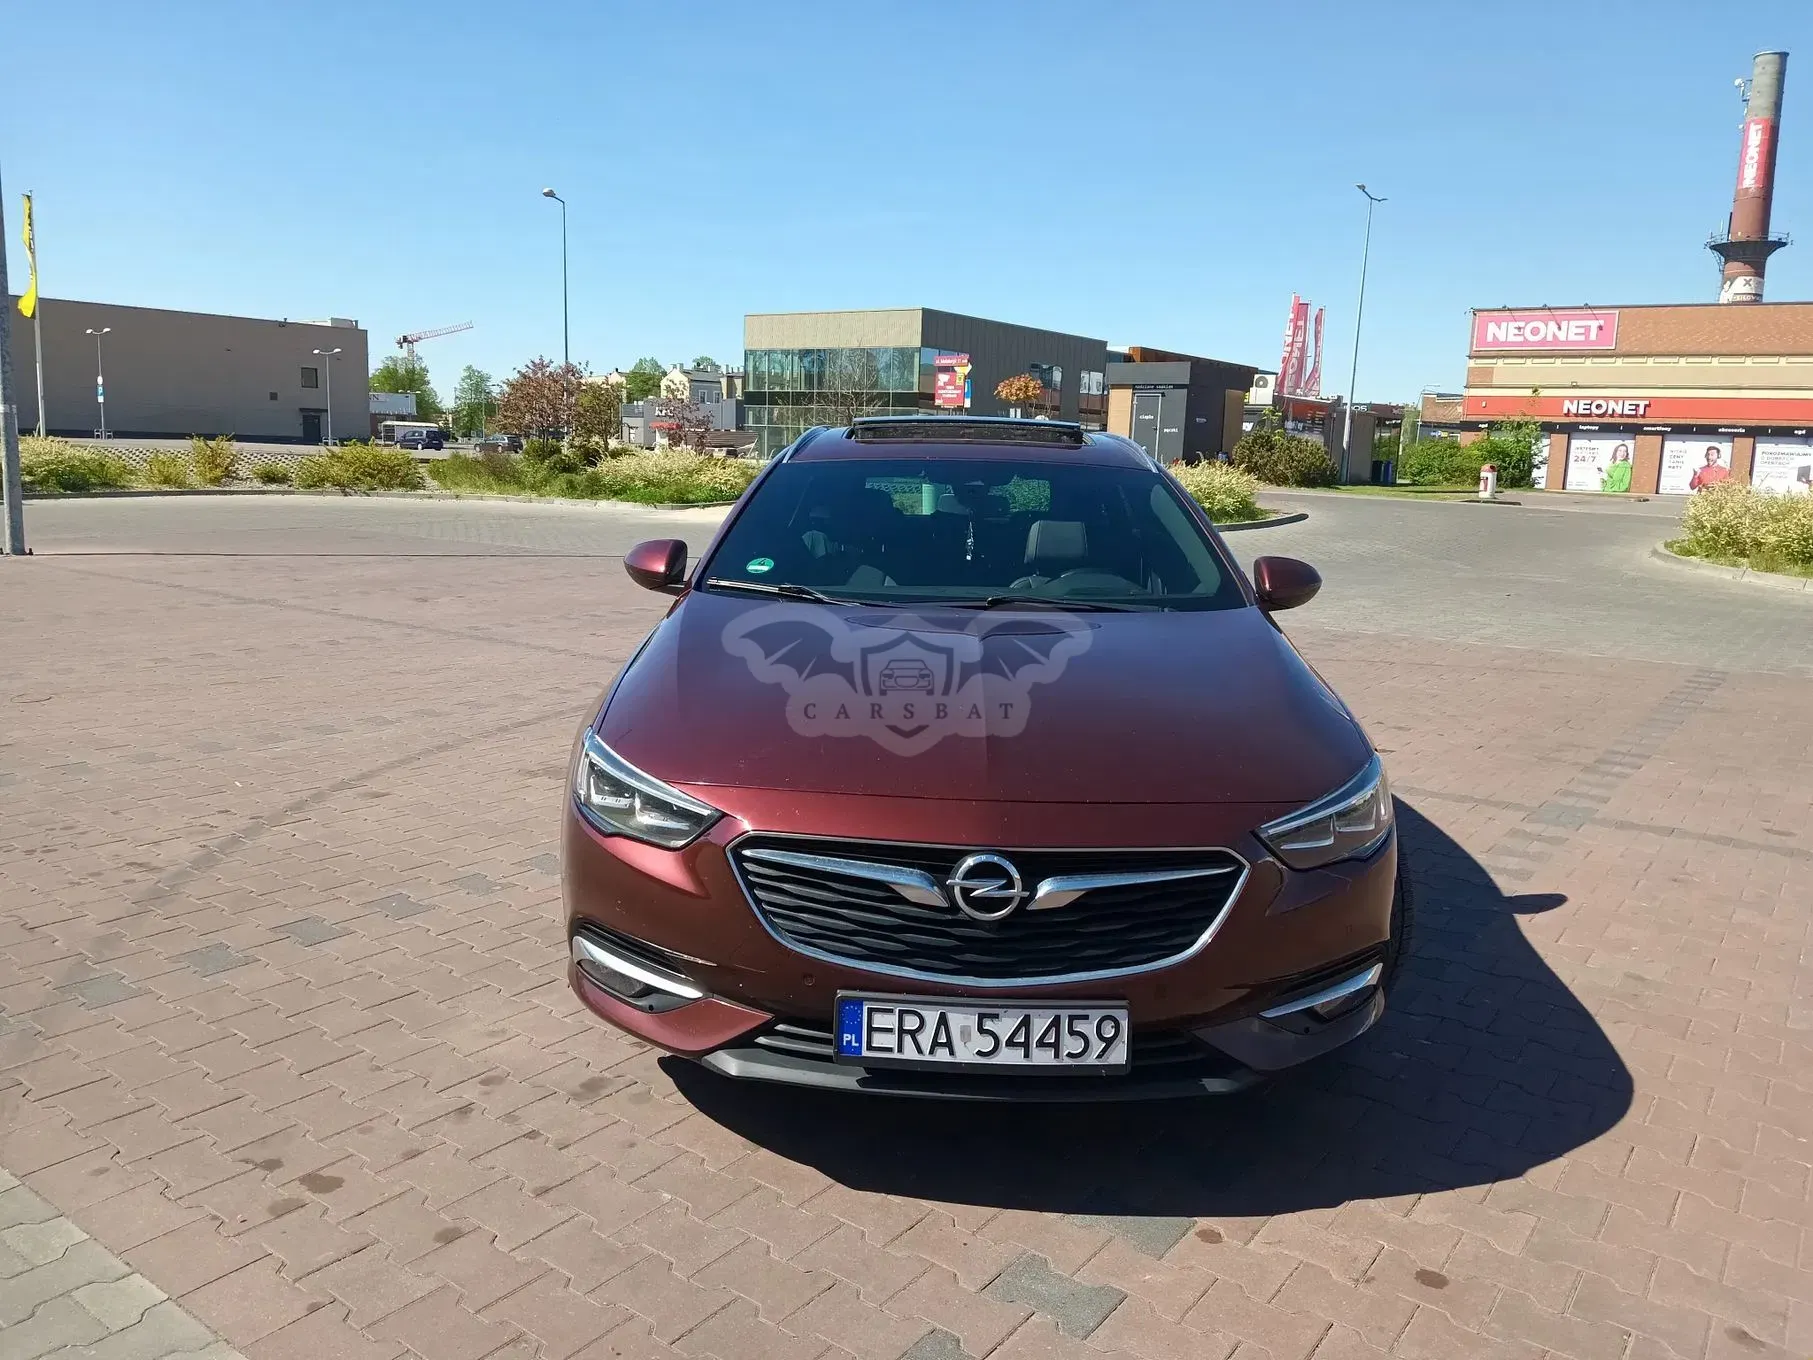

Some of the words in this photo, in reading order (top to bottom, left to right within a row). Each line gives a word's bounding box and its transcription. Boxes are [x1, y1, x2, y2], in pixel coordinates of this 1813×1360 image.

[1743, 122, 1762, 189] NEONET
[1487, 320, 1604, 342] NEONET
[1562, 400, 1651, 417] NEONET
[1574, 455, 1597, 463] 24/7
[843, 1033, 860, 1047] PL
[866, 1006, 956, 1057] ERA
[974, 1012, 1121, 1060] 54459
